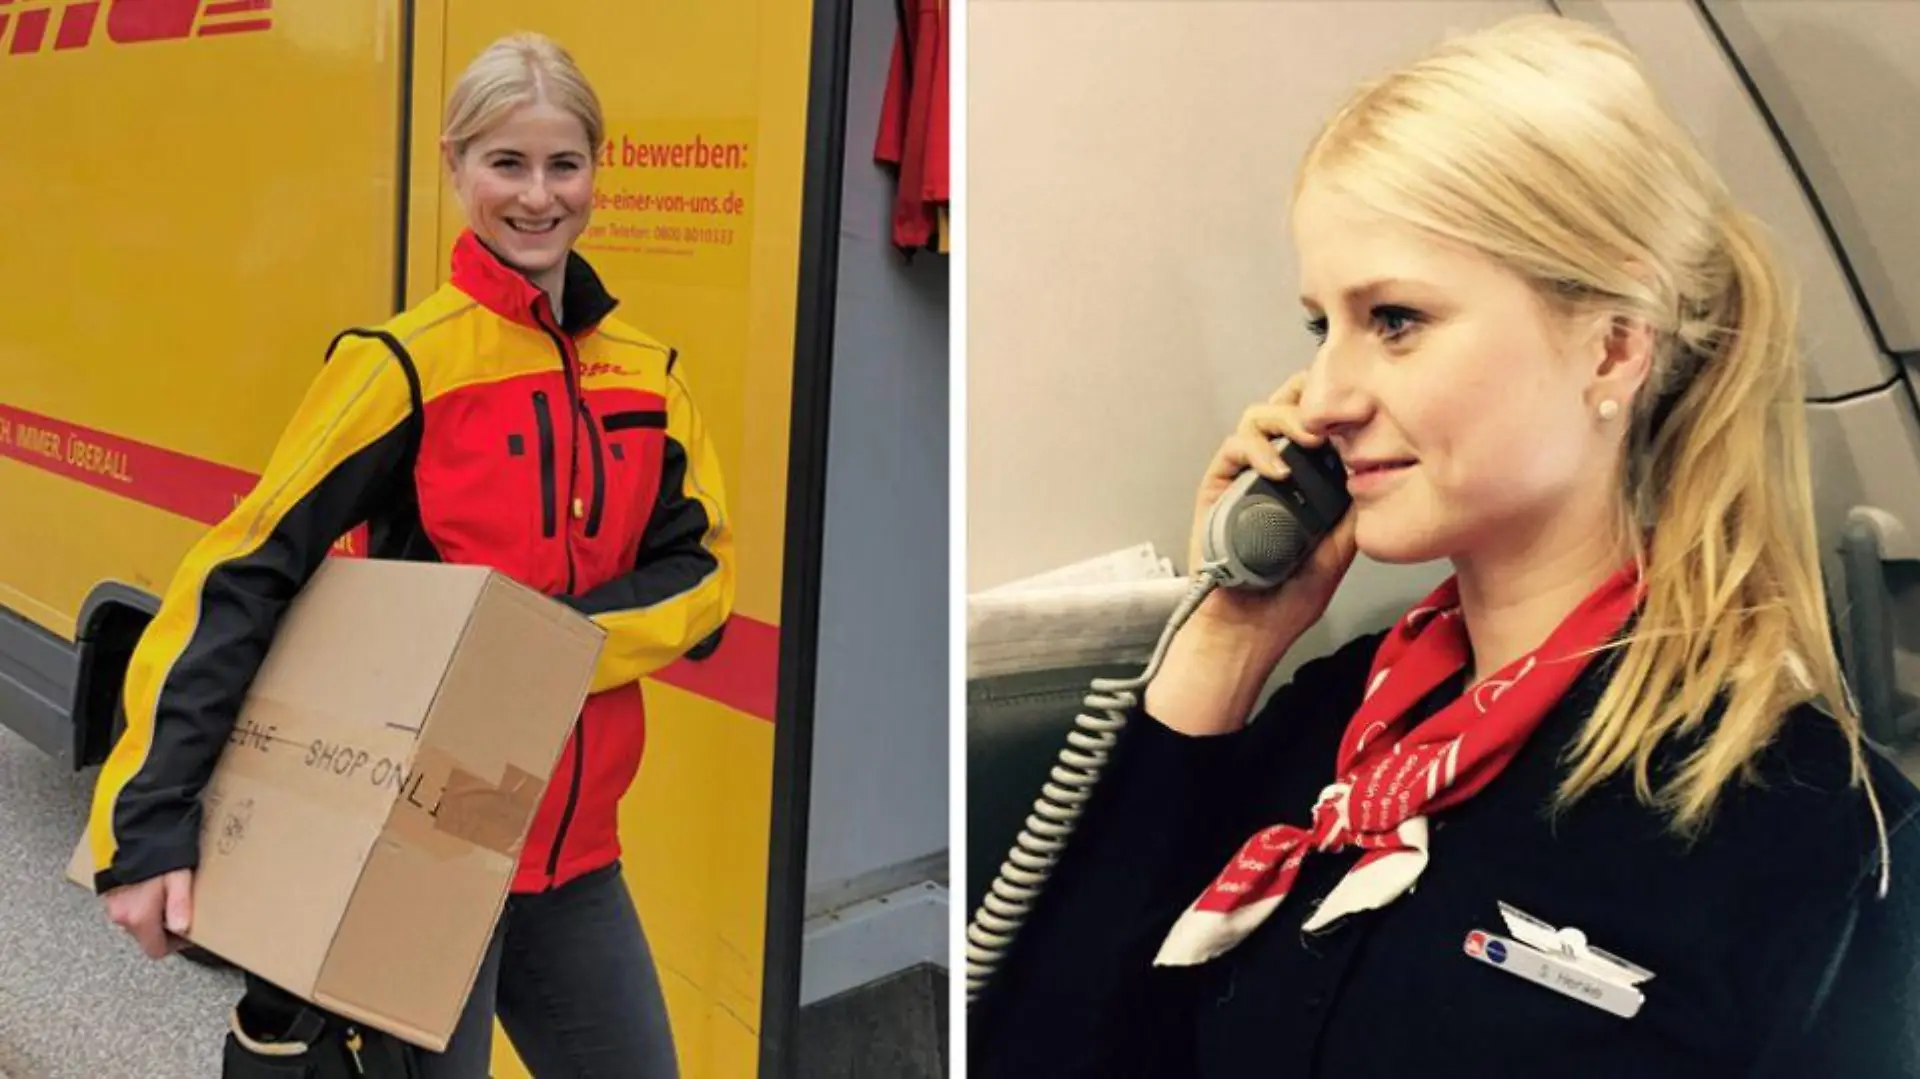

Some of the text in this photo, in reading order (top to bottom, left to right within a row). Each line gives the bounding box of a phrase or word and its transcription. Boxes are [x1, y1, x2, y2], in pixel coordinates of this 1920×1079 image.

[622, 133, 748, 170] bewerben:
[67, 431, 133, 483] ÜBERALL.
[304, 738, 368, 777] SHOP
